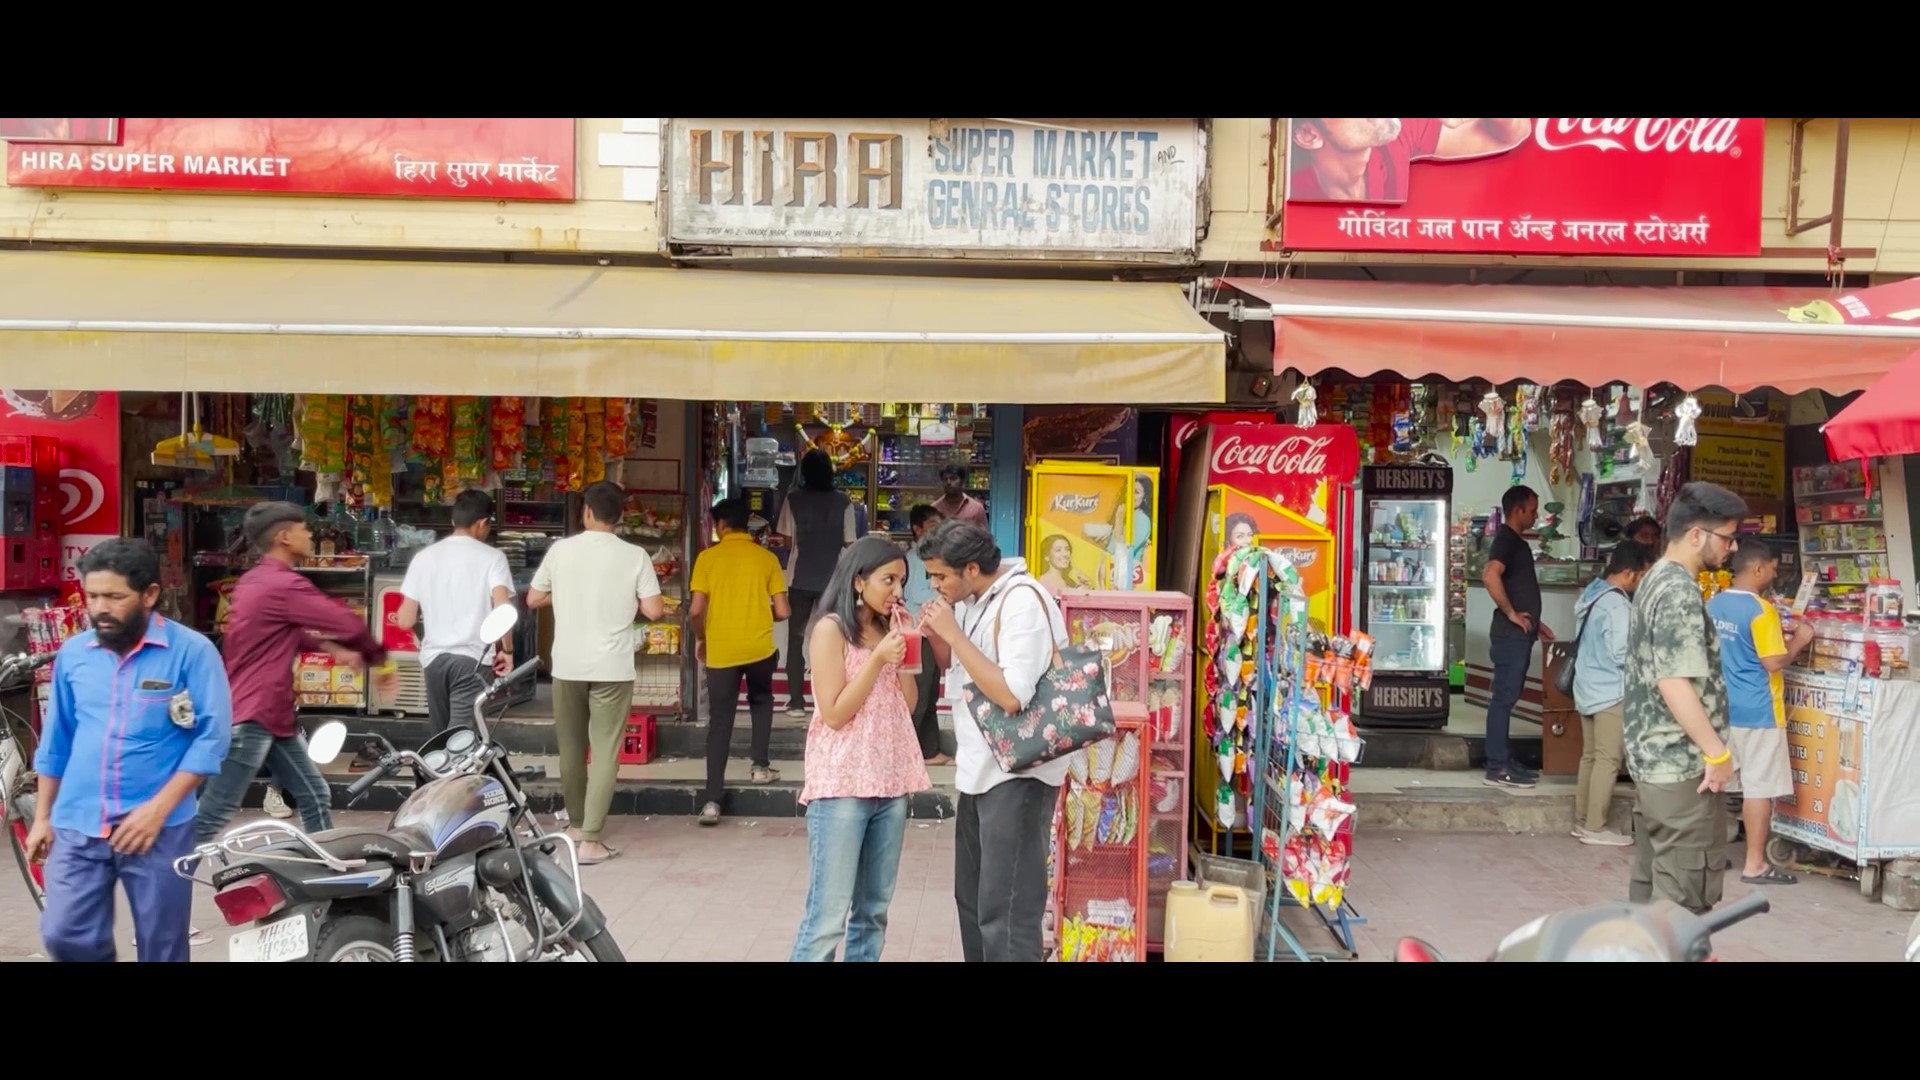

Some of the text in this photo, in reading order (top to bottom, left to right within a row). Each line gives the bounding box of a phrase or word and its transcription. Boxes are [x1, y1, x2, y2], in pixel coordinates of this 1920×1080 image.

[1535, 117, 1737, 153] CCola
[21, 150, 292, 177] HIRA SUPER MARKET
[393, 152, 560, 188] हिरा सुपर मार्केट
[690, 129, 904, 210] HIRA
[934, 127, 1159, 181] SUPER MARKET
[1157, 145, 1177, 164] AND
[927, 178, 1151, 236] GENRAL STORES
[1337, 209, 1412, 239] गोविंदा
[1416, 218, 1457, 240] जल
[1461, 218, 1504, 241] पान
[1561, 220, 1629, 245] जनरल
[1633, 215, 1711, 245] स्टोअर्स
[1211, 435, 1334, 475] Coca-Cola
[1375, 467, 1446, 490] HERSHEY'S
[1373, 686, 1443, 708] HERSHEY'S
